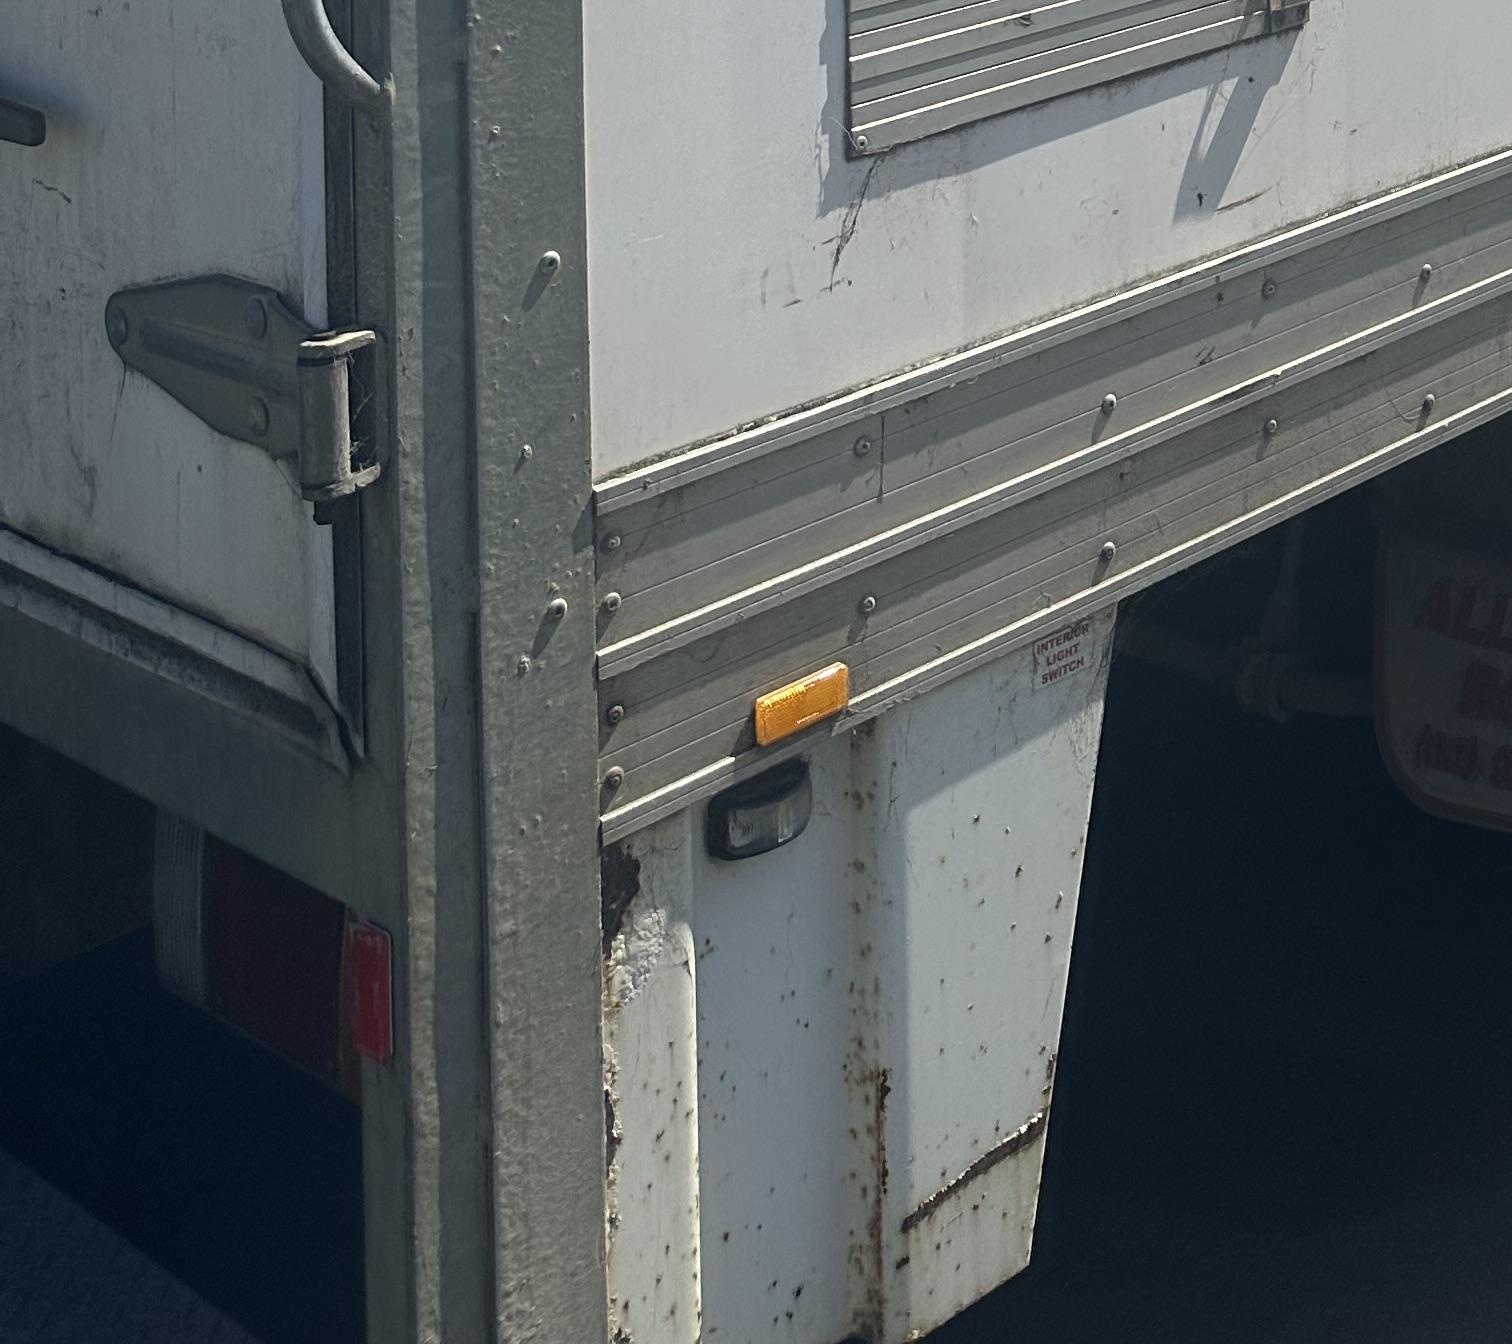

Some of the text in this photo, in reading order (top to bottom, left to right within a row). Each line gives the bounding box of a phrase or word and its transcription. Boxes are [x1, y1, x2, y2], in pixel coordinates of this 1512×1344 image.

[1036, 623, 1090, 655] INTERIOR
[1046, 643, 1080, 667] LIGHT
[1041, 656, 1085, 685] SWITCH
